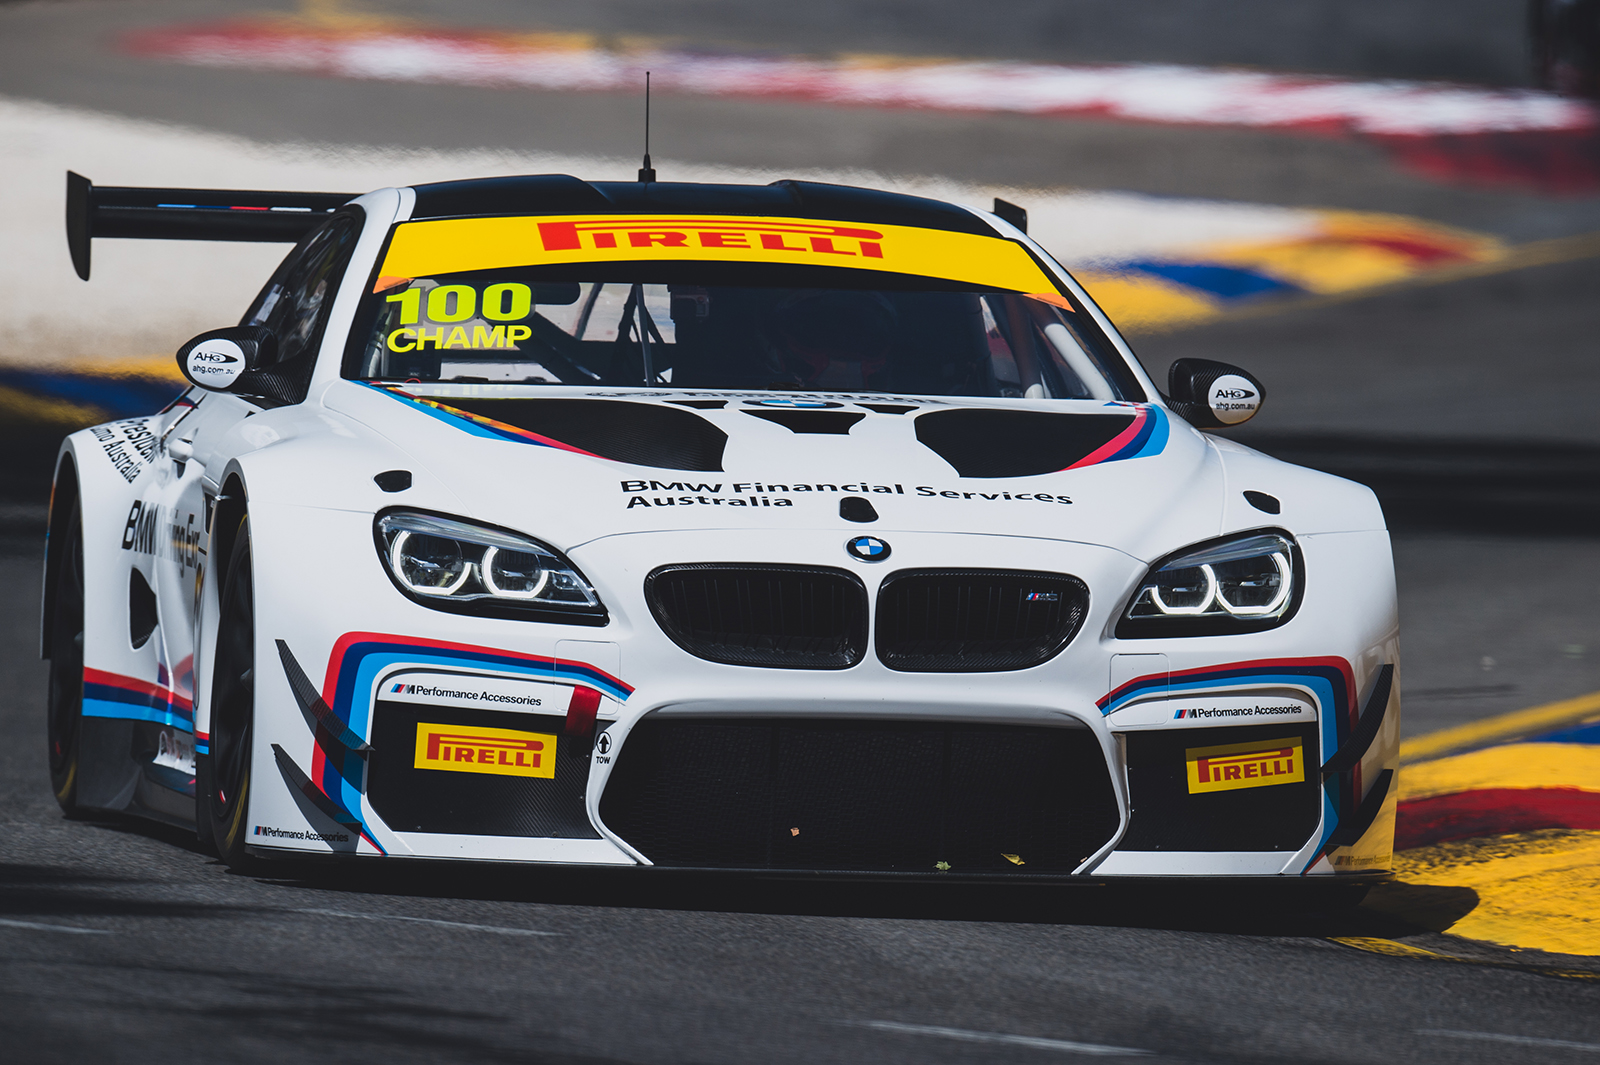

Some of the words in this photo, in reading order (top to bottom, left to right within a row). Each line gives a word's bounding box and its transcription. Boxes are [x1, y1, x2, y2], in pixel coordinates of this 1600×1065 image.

[537, 219, 884, 259] PIRELLI
[386, 283, 532, 325] 100
[386, 325, 532, 353] CHAMP
[194, 352, 221, 361] AHG
[193, 365, 236, 375] ahg.com.au
[1215, 389, 1242, 399] AHG
[1215, 402, 1256, 411] ahg.com.au
[102, 440, 142, 485] Australia
[620, 480, 722, 493] BMW
[732, 482, 905, 495] Financial
[915, 486, 1074, 505] Services
[626, 495, 794, 509] Australia
[121, 499, 159, 556] BMW
[416, 685, 478, 700] Performance
[480, 691, 542, 707] Accessories
[1198, 706, 1253, 718] Performance
[1254, 704, 1302, 716] Accessories
[426, 732, 544, 768] PIRELLI
[596, 756, 611, 764] TOW
[1197, 747, 1294, 783] PIRELLI
[268, 827, 305, 840] Performance
[305, 830, 349, 842] Accessories
